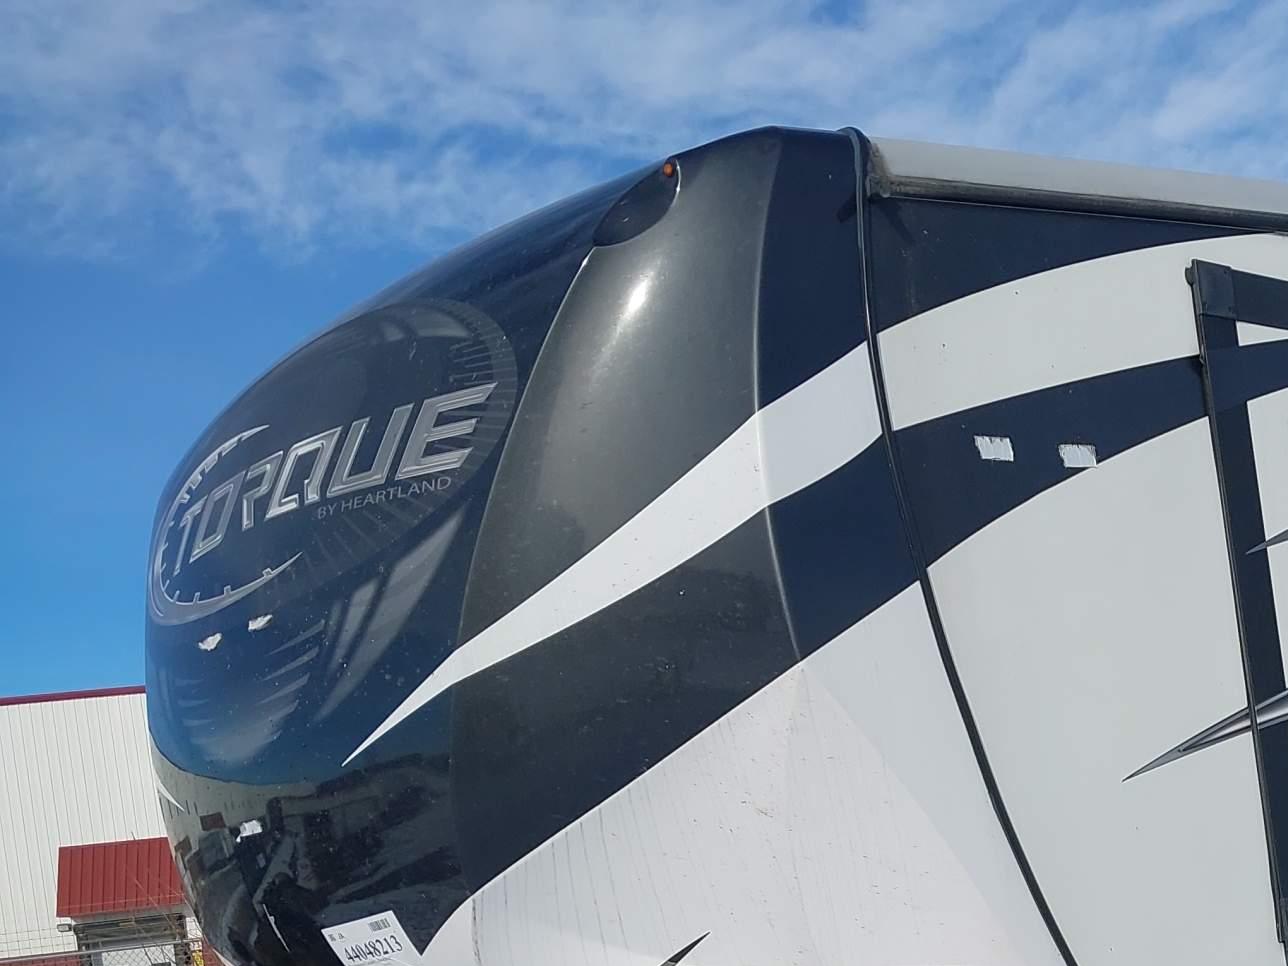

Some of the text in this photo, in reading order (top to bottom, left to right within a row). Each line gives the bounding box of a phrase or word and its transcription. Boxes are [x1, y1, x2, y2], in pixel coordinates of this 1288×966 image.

[174, 381, 498, 575] TORQUE
[317, 475, 453, 521] BY HEARTLAND
[344, 934, 403, 963] 44048213
